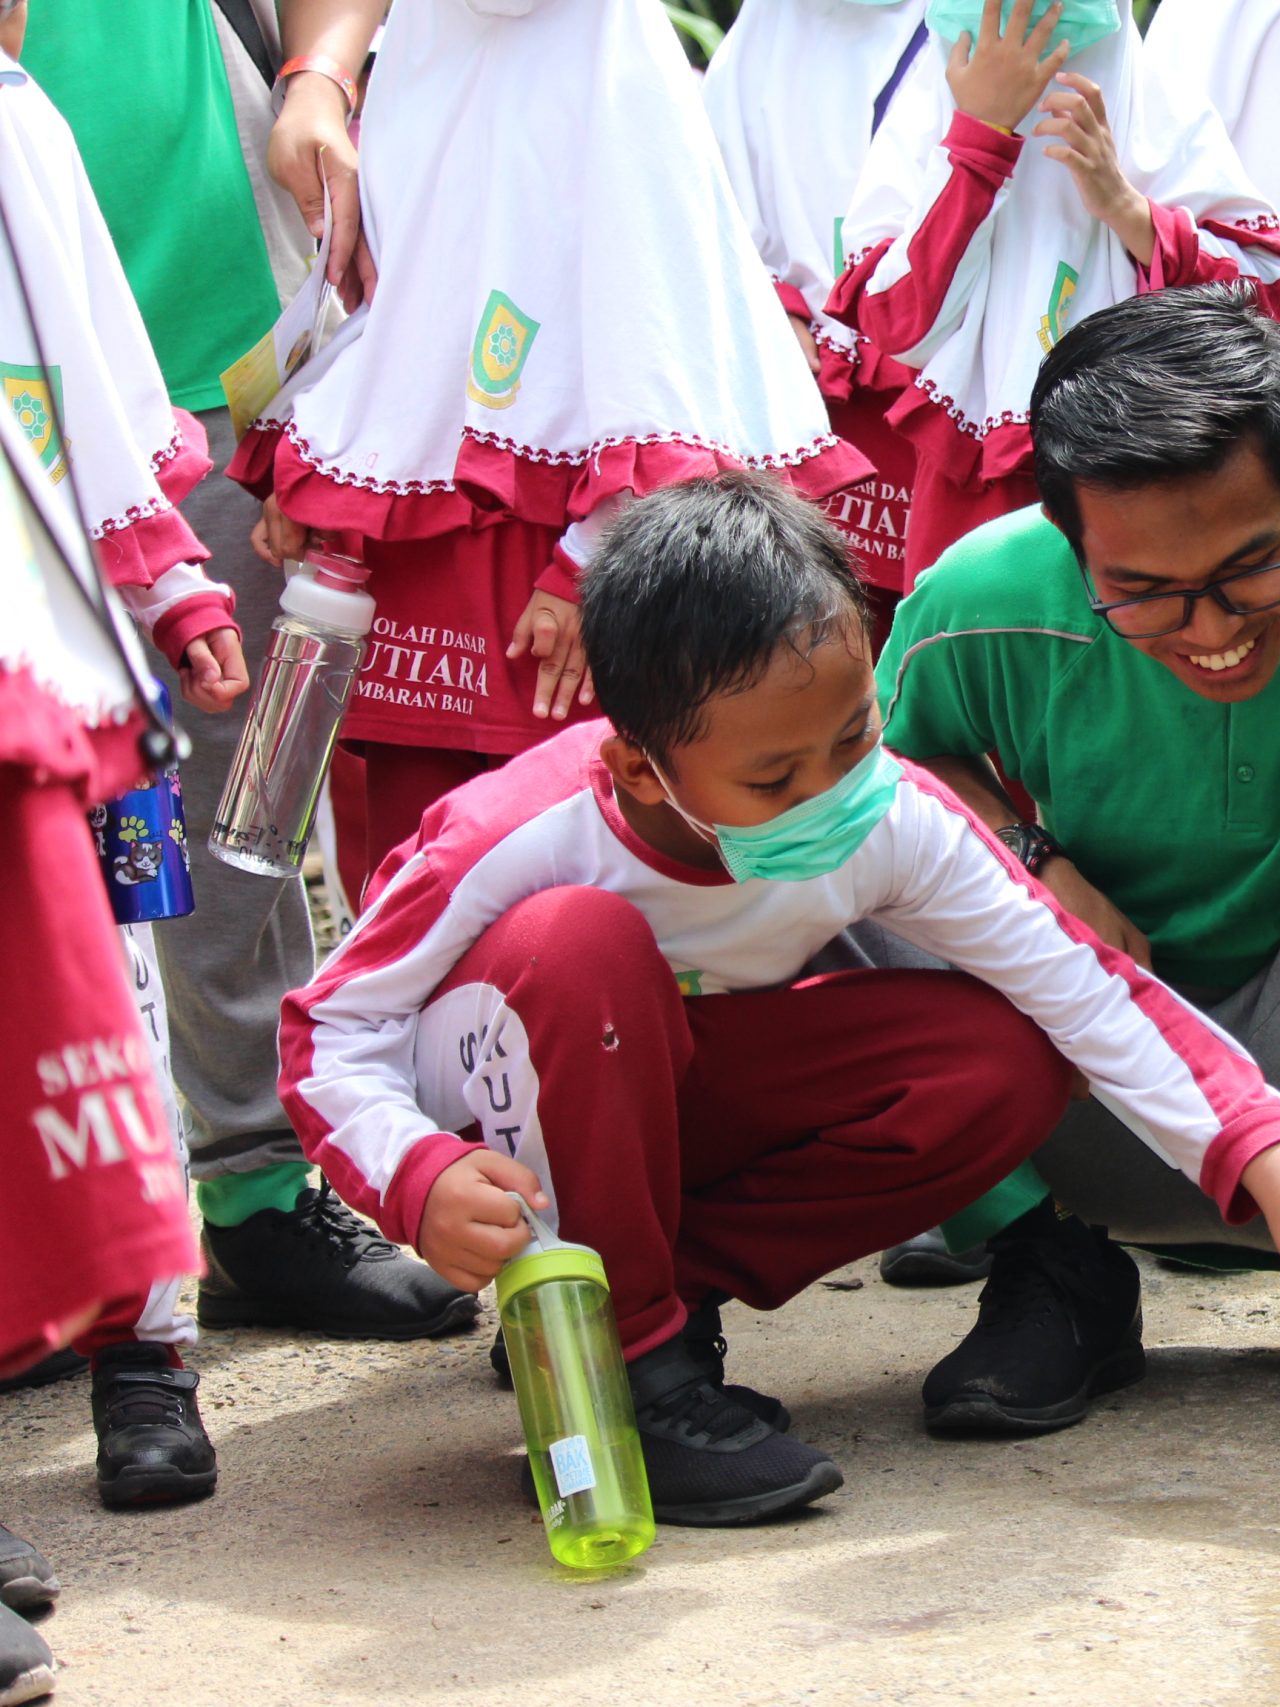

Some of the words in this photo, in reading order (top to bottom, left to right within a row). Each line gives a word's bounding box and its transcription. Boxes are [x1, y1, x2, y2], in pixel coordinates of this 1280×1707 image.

[881, 483, 914, 503] DA
[441, 628, 486, 655] DASAR
[441, 694, 473, 715] BALI
[556, 1449, 588, 1475] BAK
